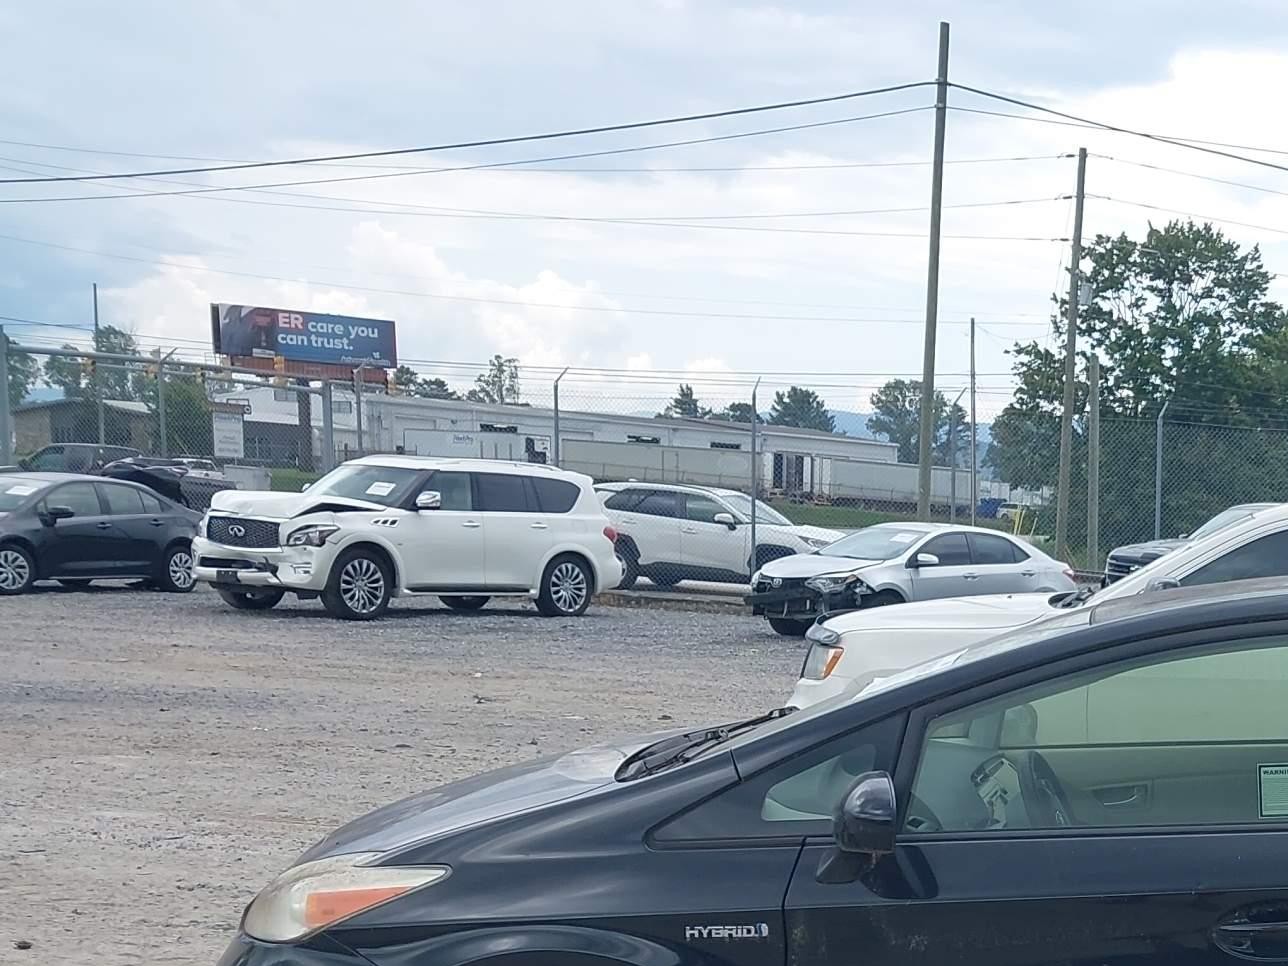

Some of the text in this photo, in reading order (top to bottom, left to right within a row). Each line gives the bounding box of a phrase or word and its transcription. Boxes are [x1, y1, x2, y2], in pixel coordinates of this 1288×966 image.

[278, 312, 378, 339] ER care you
[277, 333, 354, 351] can trust.
